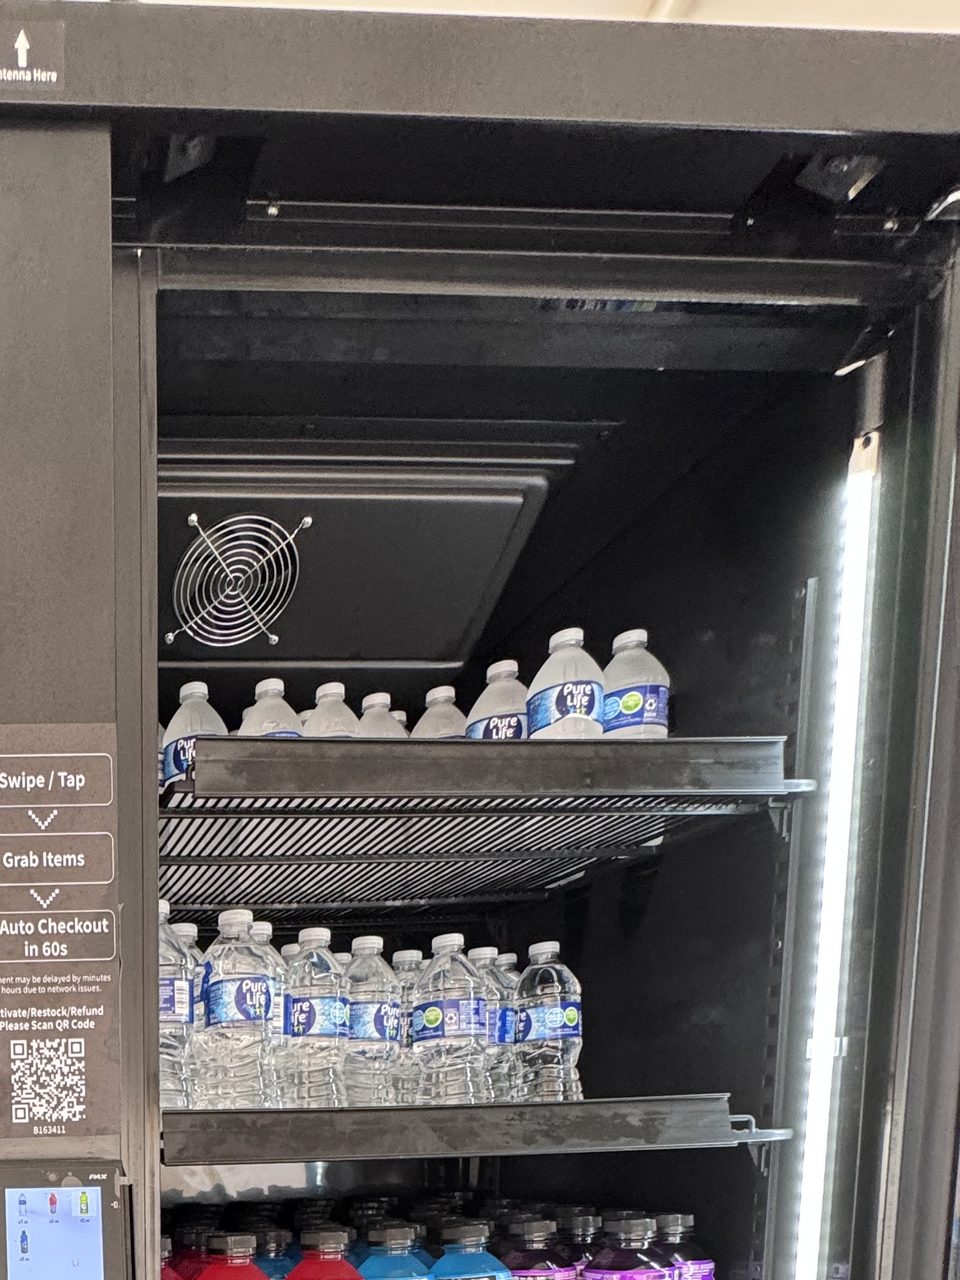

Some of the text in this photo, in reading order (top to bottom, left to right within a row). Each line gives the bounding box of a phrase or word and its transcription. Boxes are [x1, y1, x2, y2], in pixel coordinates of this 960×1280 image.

[33, 68, 57, 82] Here
[563, 683, 591, 696] Pure
[566, 694, 589, 709] Life
[490, 715, 517, 730] Pure
[492, 726, 516, 739] Life
[177, 738, 196, 750] Pur
[48, 770, 54, 791] /
[58, 772, 85, 790] Tap
[2, 851, 84, 868] Grab Items
[0, 918, 108, 935] Auto Checkout
[24, 941, 68, 956] in 60s
[42, 974, 70, 984] delayed
[72, 974, 81, 984] by
[82, 974, 111, 982] minutes
[1, 986, 22, 994] hours
[22, 985, 36, 994] due
[47, 984, 77, 993] network
[78, 984, 102, 992] issues.
[242, 980, 266, 993] Pure
[246, 992, 266, 1007] Life
[380, 1004, 400, 1017] Pure
[292, 1012, 308, 1024] ife
[383, 1015, 398, 1029] Life
[0, 1020, 95, 1031] Please Scan QR Code
[33, 1126, 66, 1134] B163411
